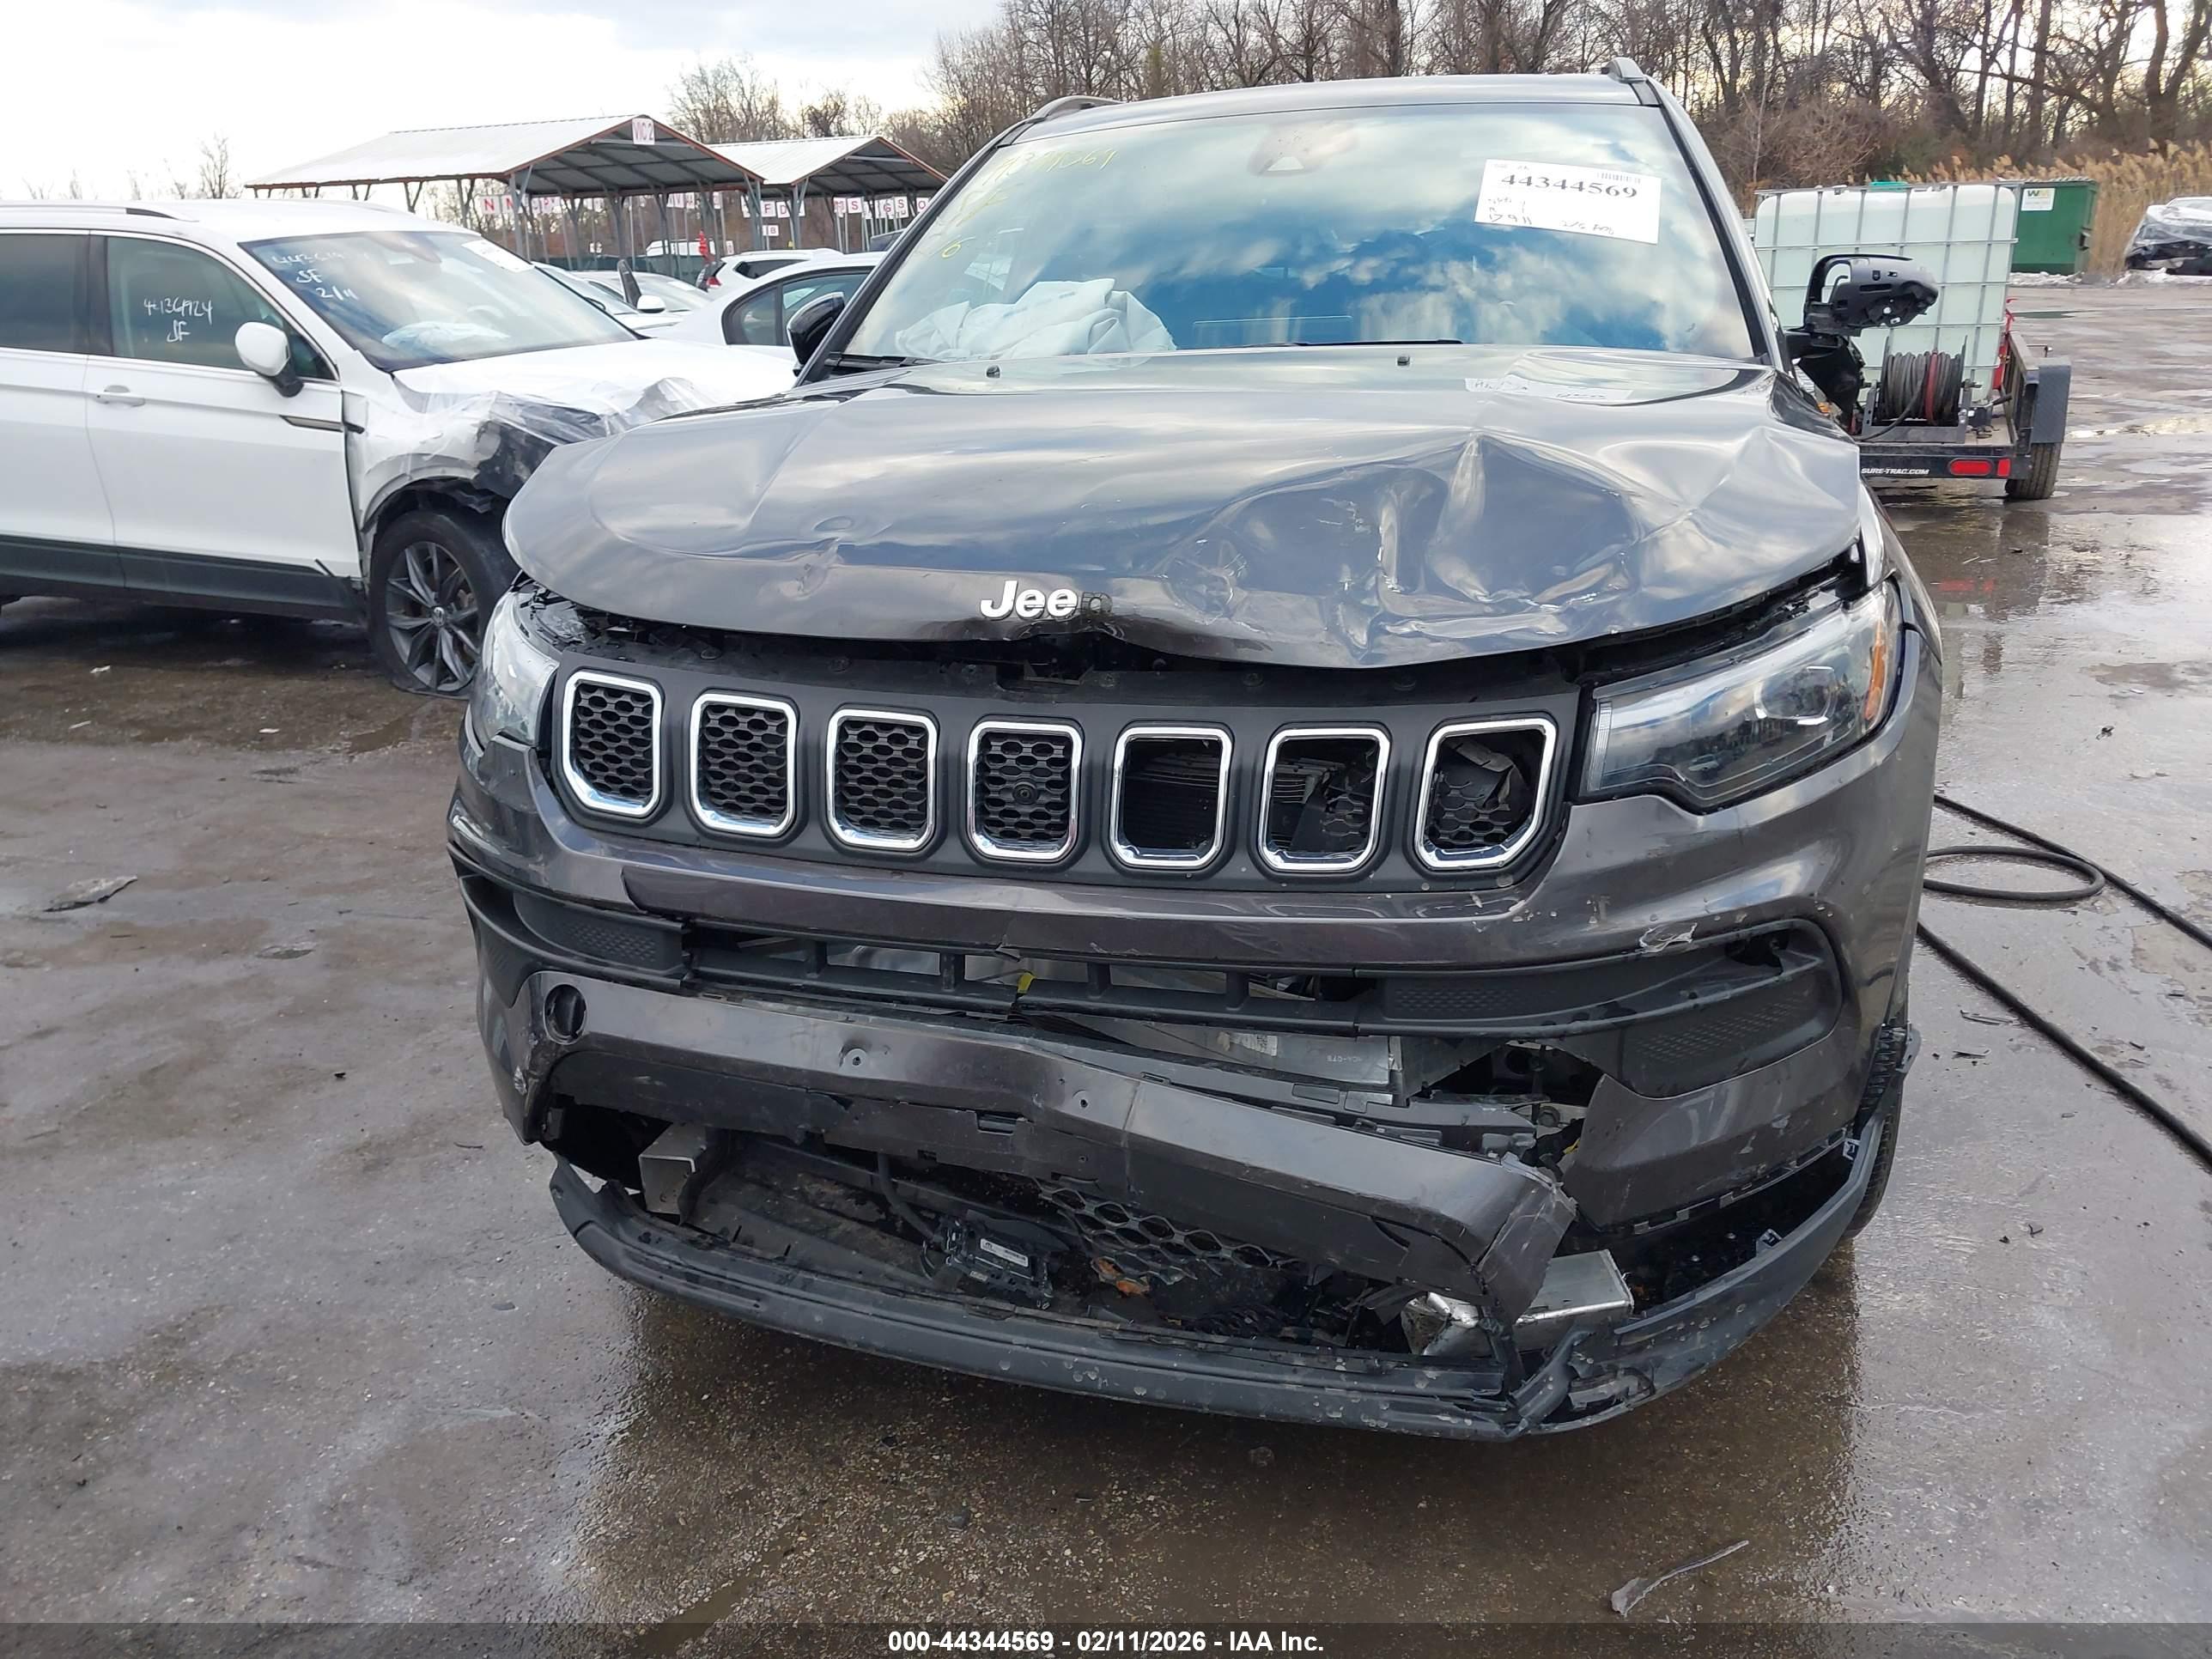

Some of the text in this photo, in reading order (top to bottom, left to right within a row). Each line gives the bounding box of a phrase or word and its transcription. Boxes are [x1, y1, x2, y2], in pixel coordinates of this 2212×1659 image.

[1501, 174, 1638, 198] 44344569
[484, 198, 495, 211] N
[764, 204, 771, 214] F
[851, 201, 859, 210] S
[897, 199, 905, 209] S
